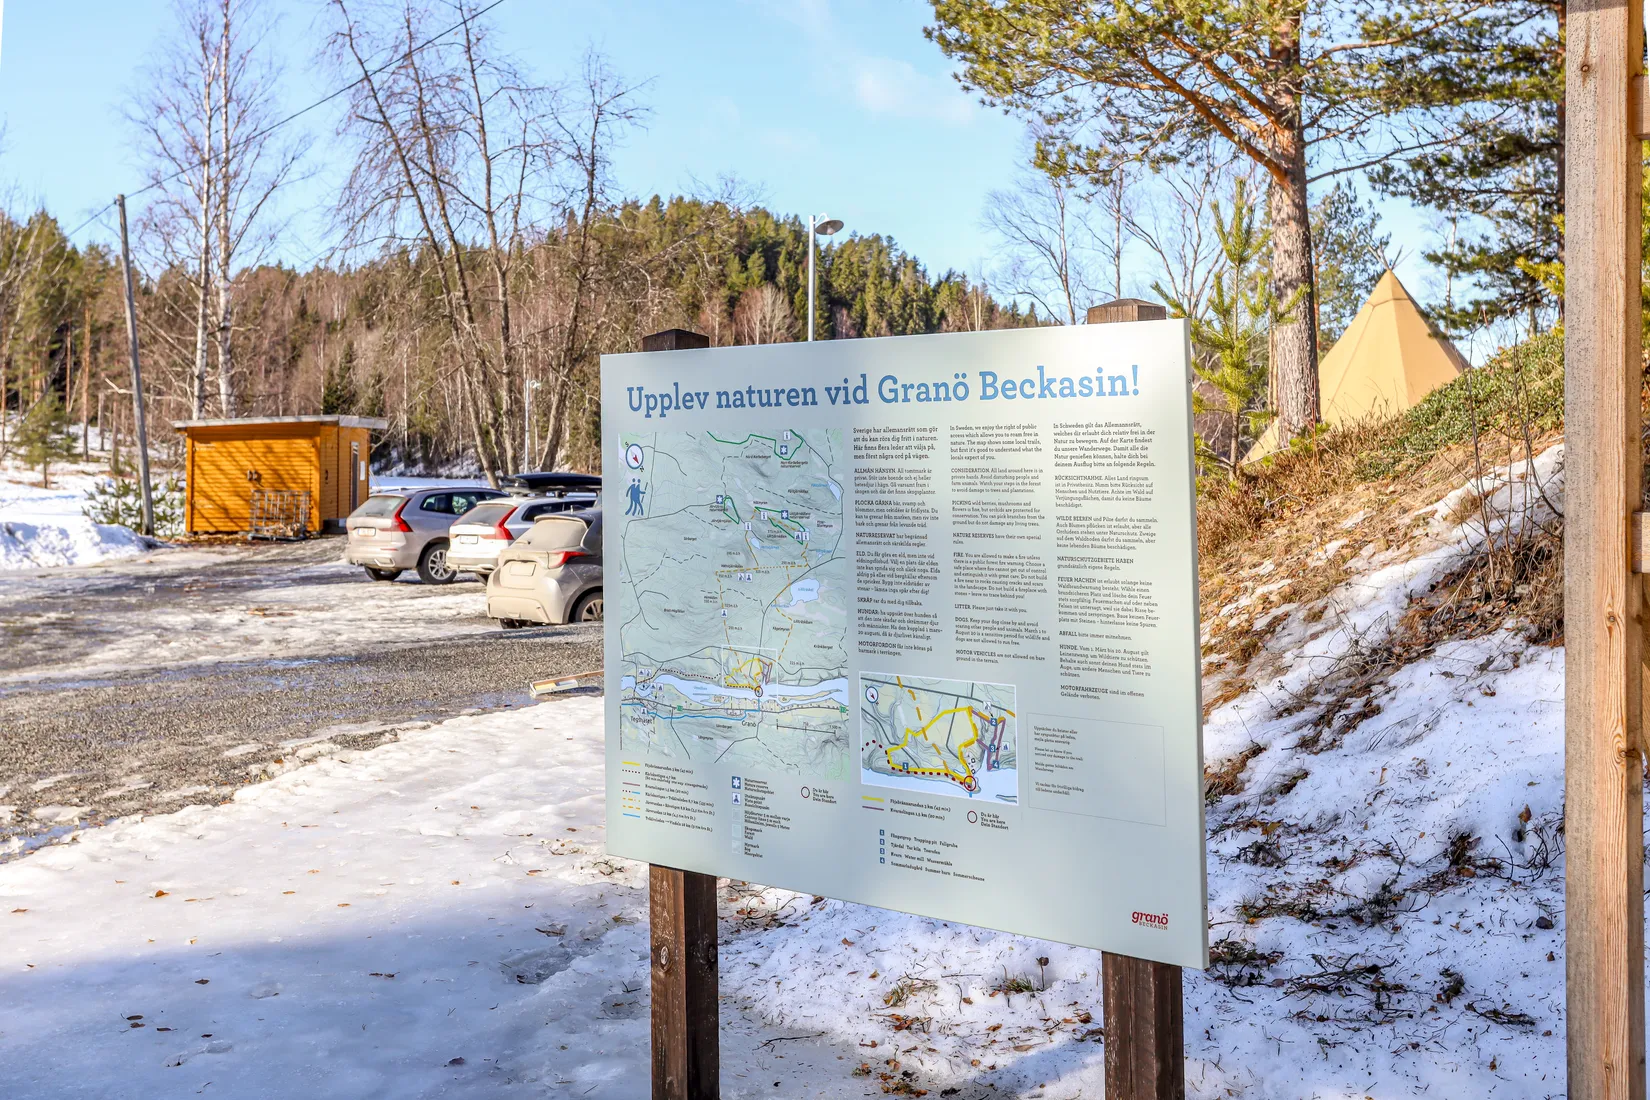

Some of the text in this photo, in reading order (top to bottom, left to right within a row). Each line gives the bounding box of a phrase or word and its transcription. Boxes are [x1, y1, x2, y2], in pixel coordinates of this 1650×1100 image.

[627, 365, 1140, 418] Upplev naturen vid Granö Beckasin!
[891, 435, 900, 443] dig
[1132, 911, 1168, 925] granö
[1139, 921, 1168, 930] BECKASIN
